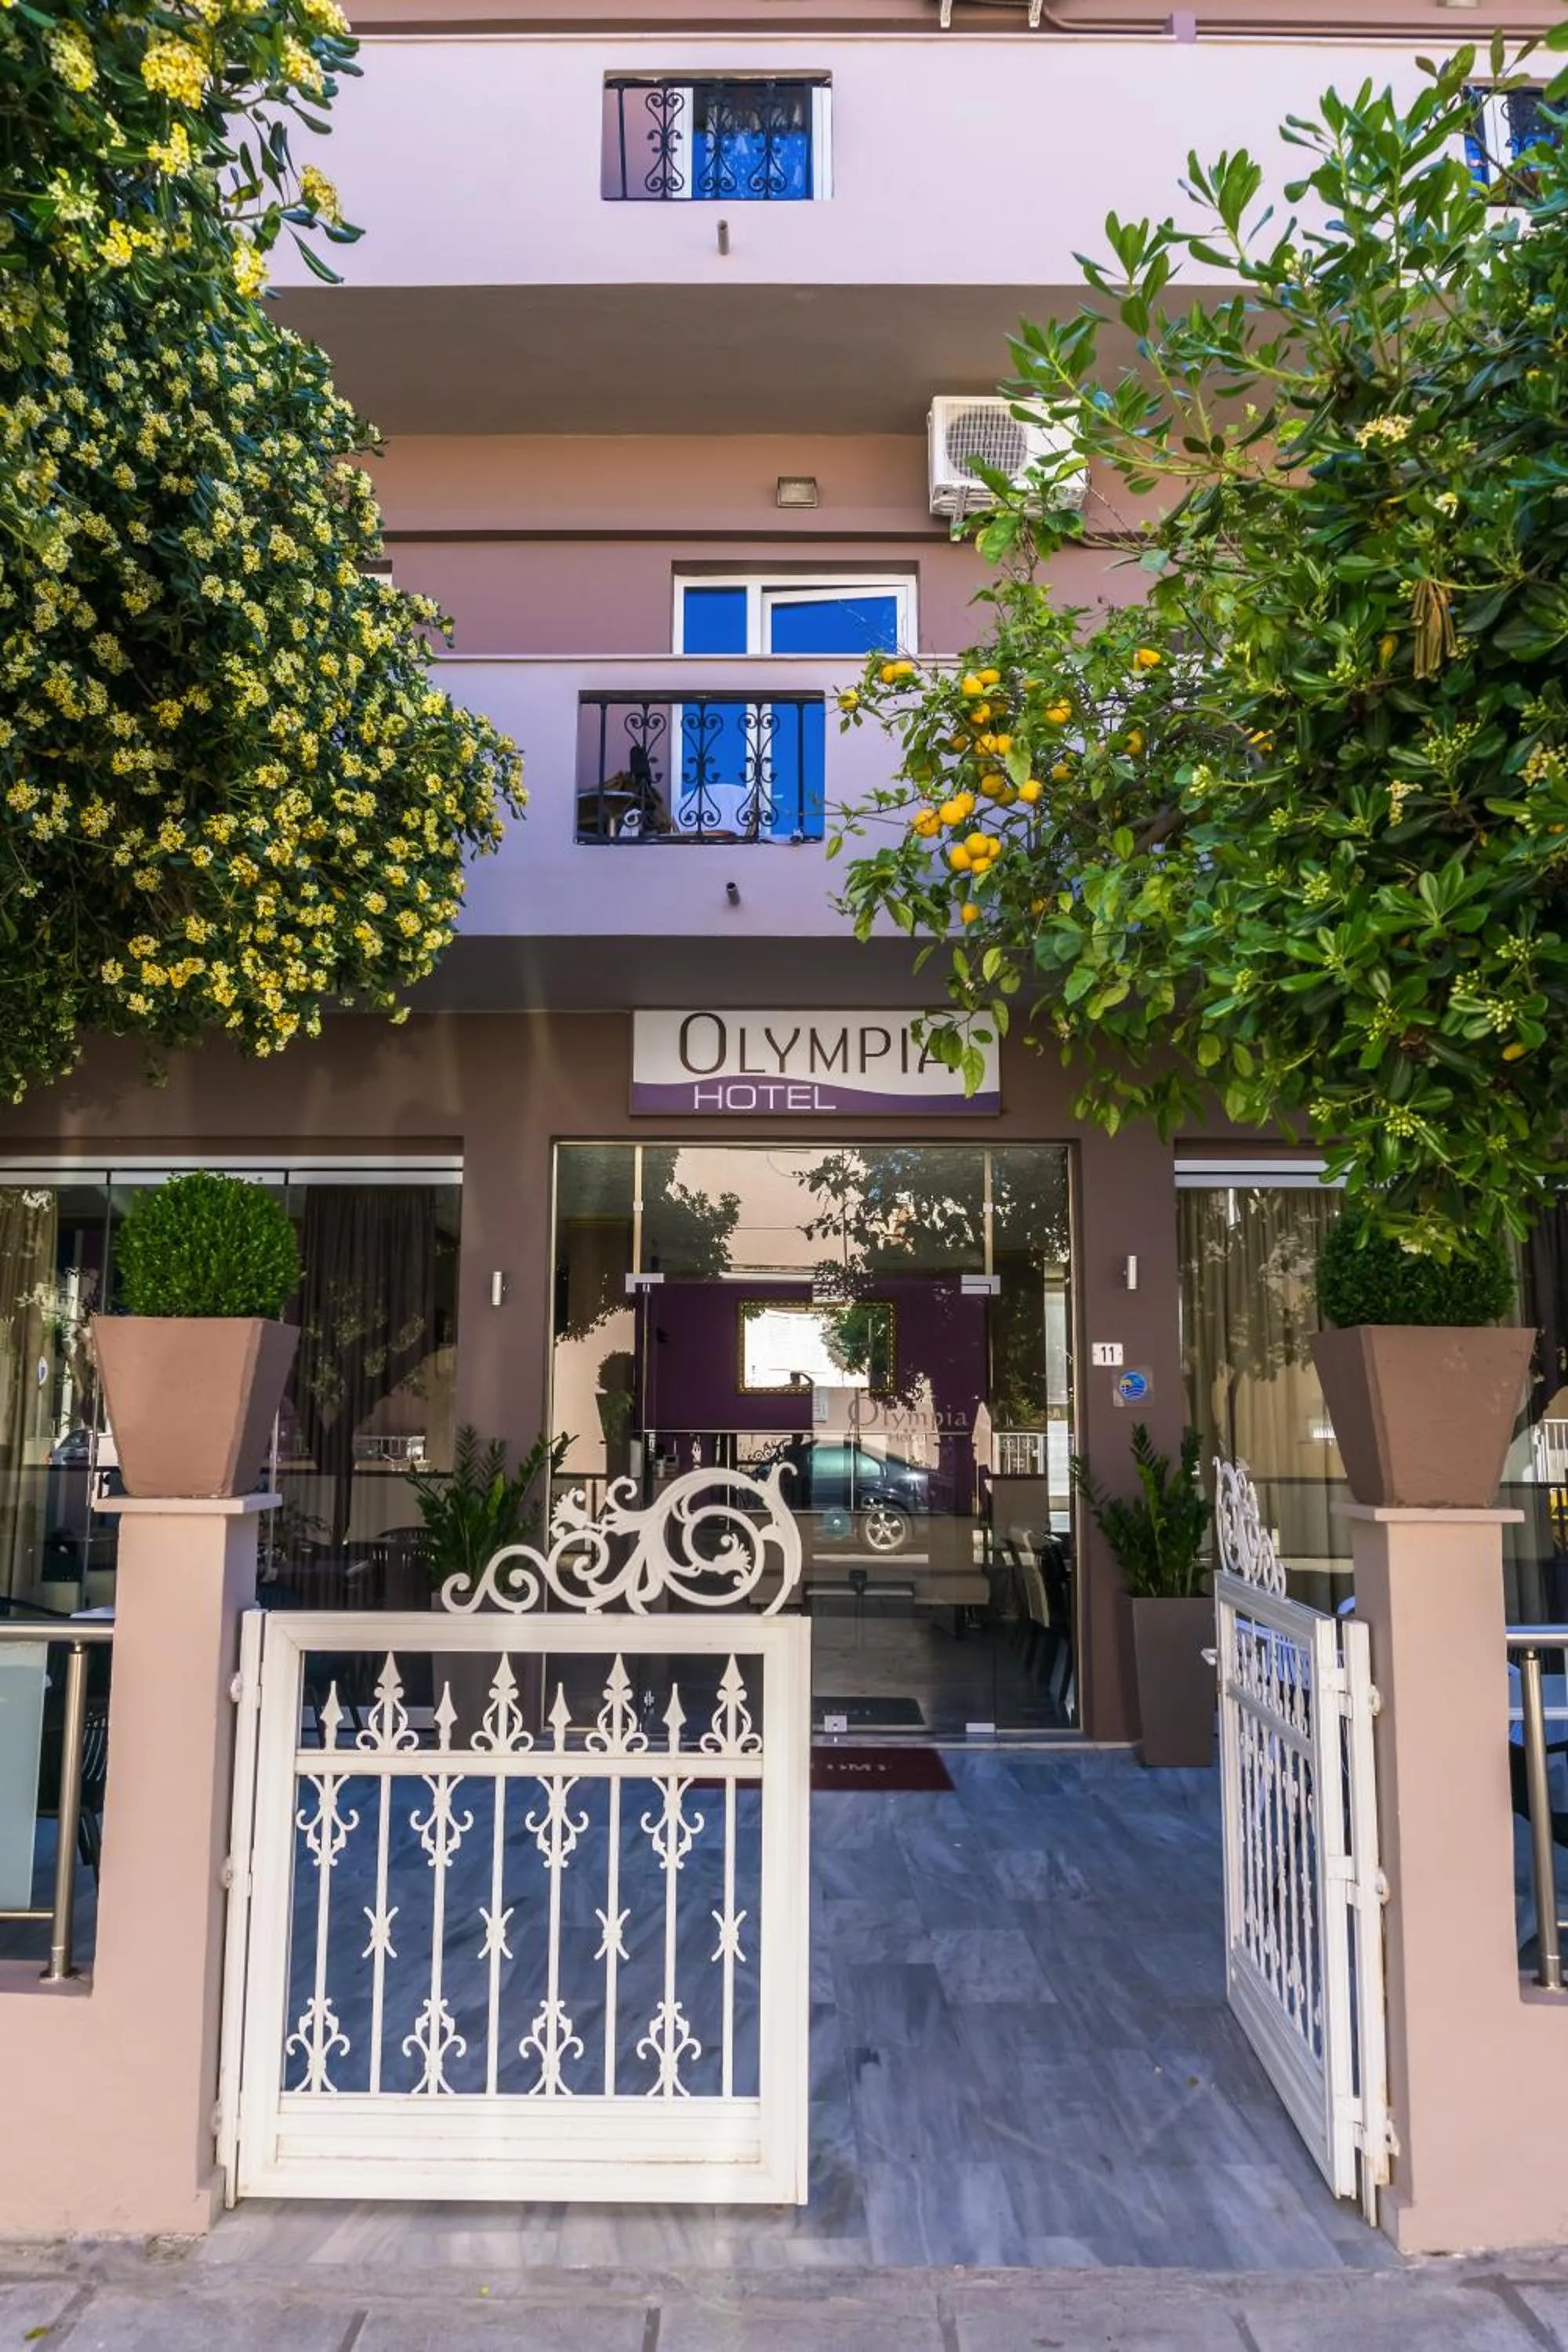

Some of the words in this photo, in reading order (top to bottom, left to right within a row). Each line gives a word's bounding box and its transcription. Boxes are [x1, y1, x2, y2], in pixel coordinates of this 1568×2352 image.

[679, 1012, 955, 1074] OLYMPIA
[694, 1085, 837, 1109] HOTEL
[1102, 1346, 1114, 1363] 11
[848, 1396, 967, 1432] Olympia
